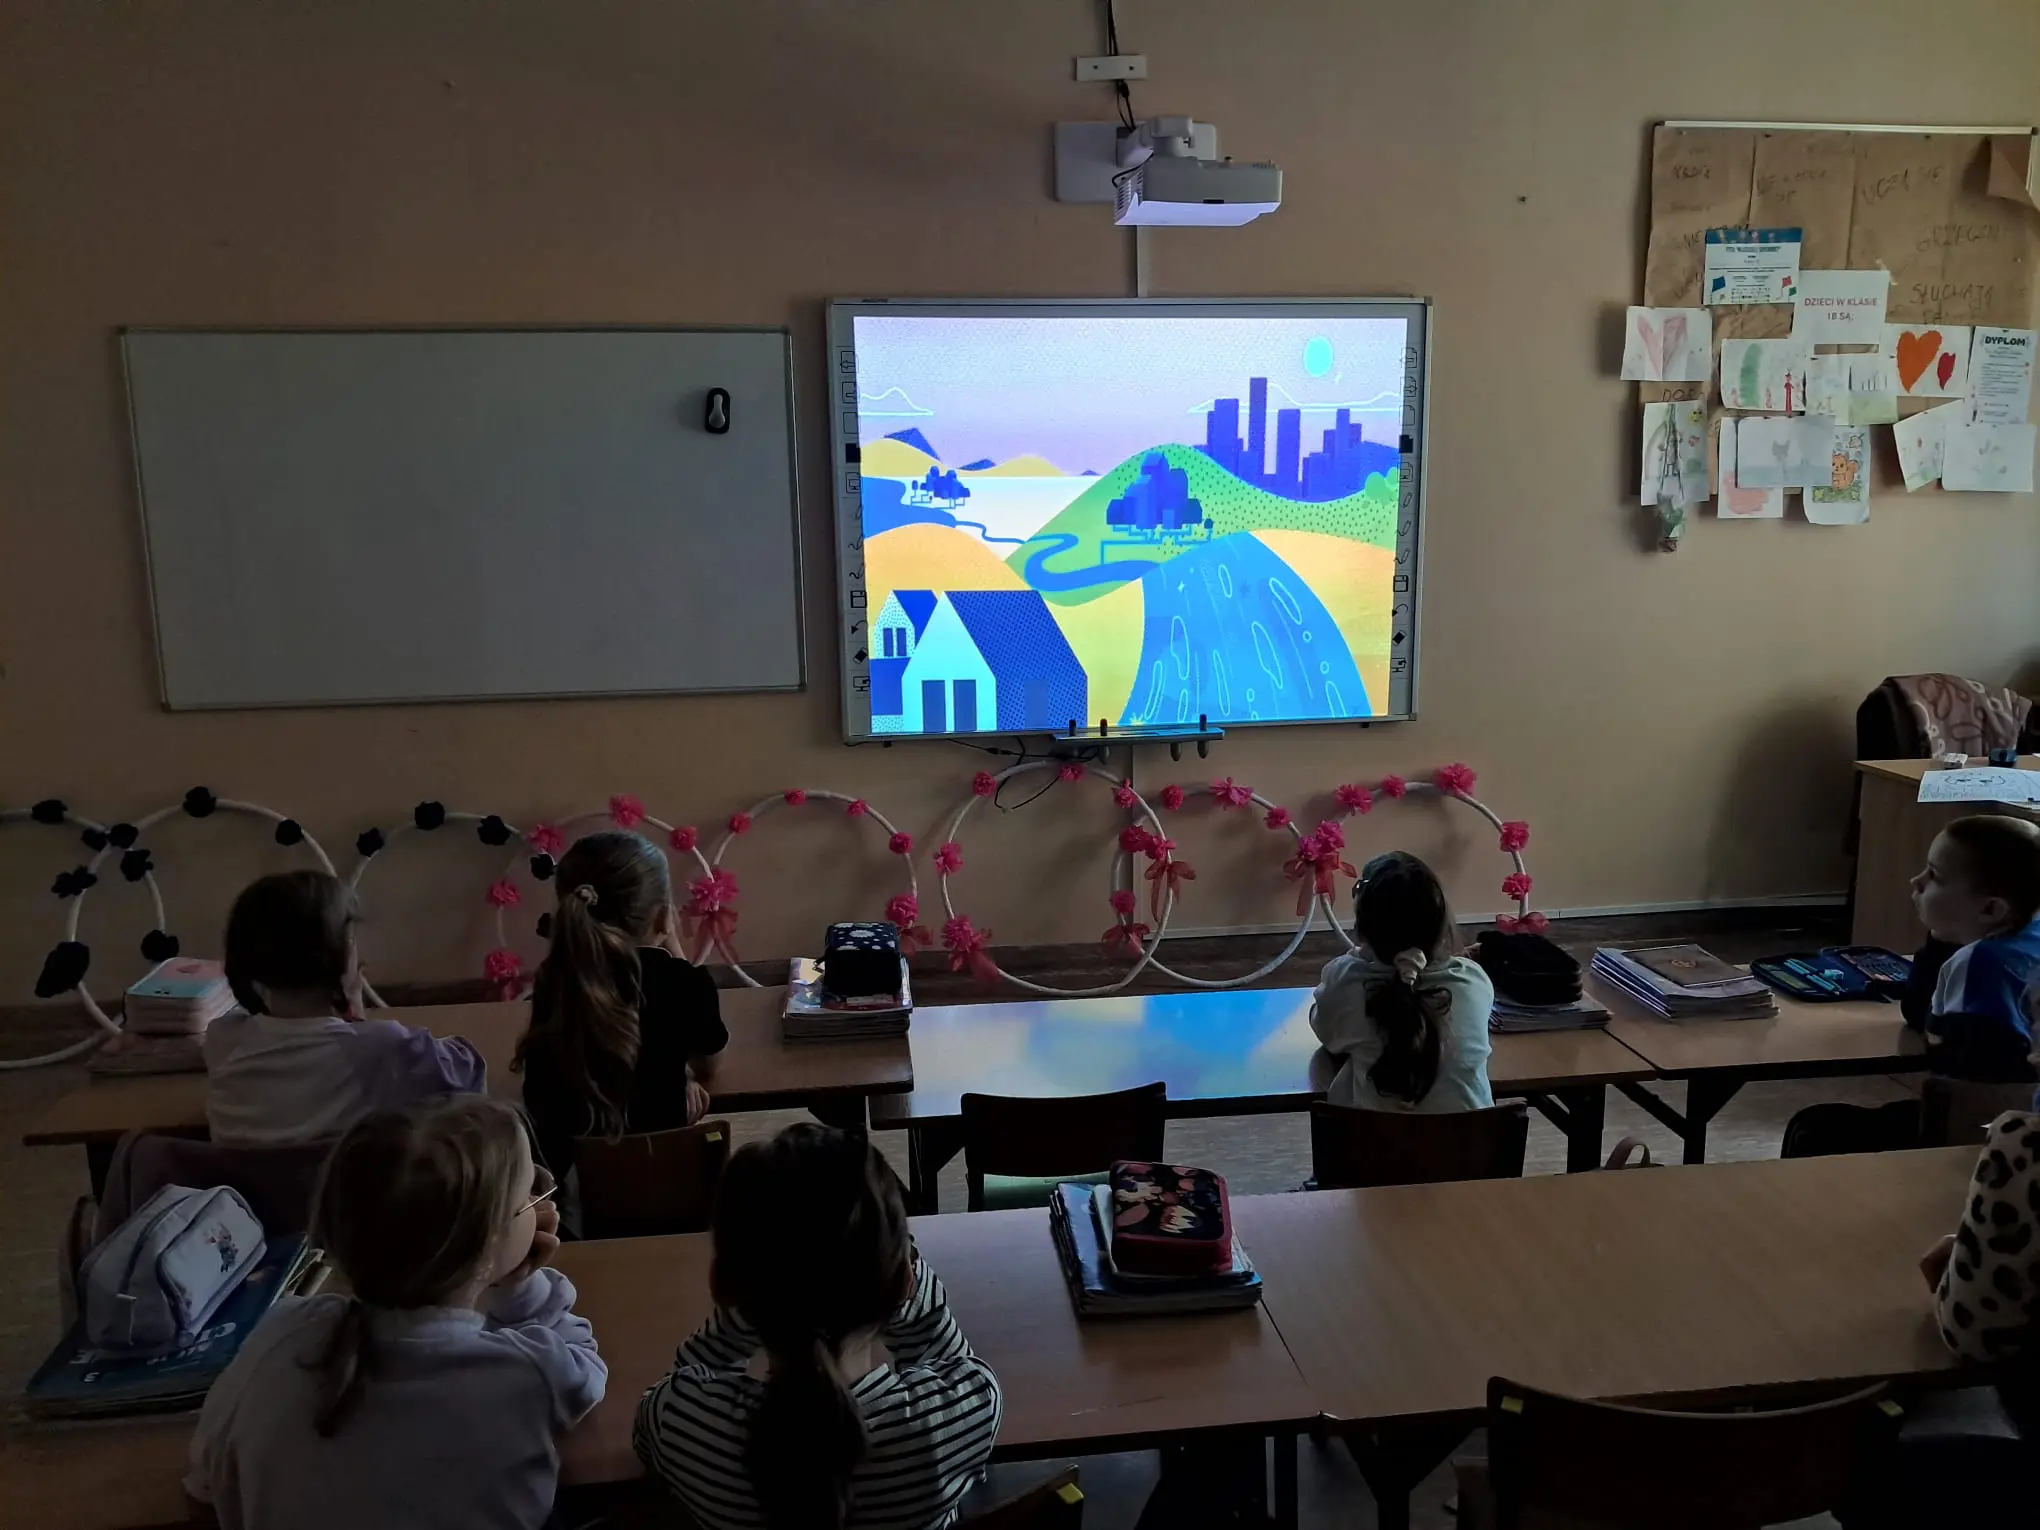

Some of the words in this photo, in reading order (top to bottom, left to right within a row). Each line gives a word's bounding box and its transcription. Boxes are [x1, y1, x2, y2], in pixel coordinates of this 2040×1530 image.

[1804, 297, 1835, 307] DZIECI
[1836, 297, 1846, 307] W
[1847, 297, 1878, 307] KLASIE
[1984, 335, 2026, 347] DYPLOM
